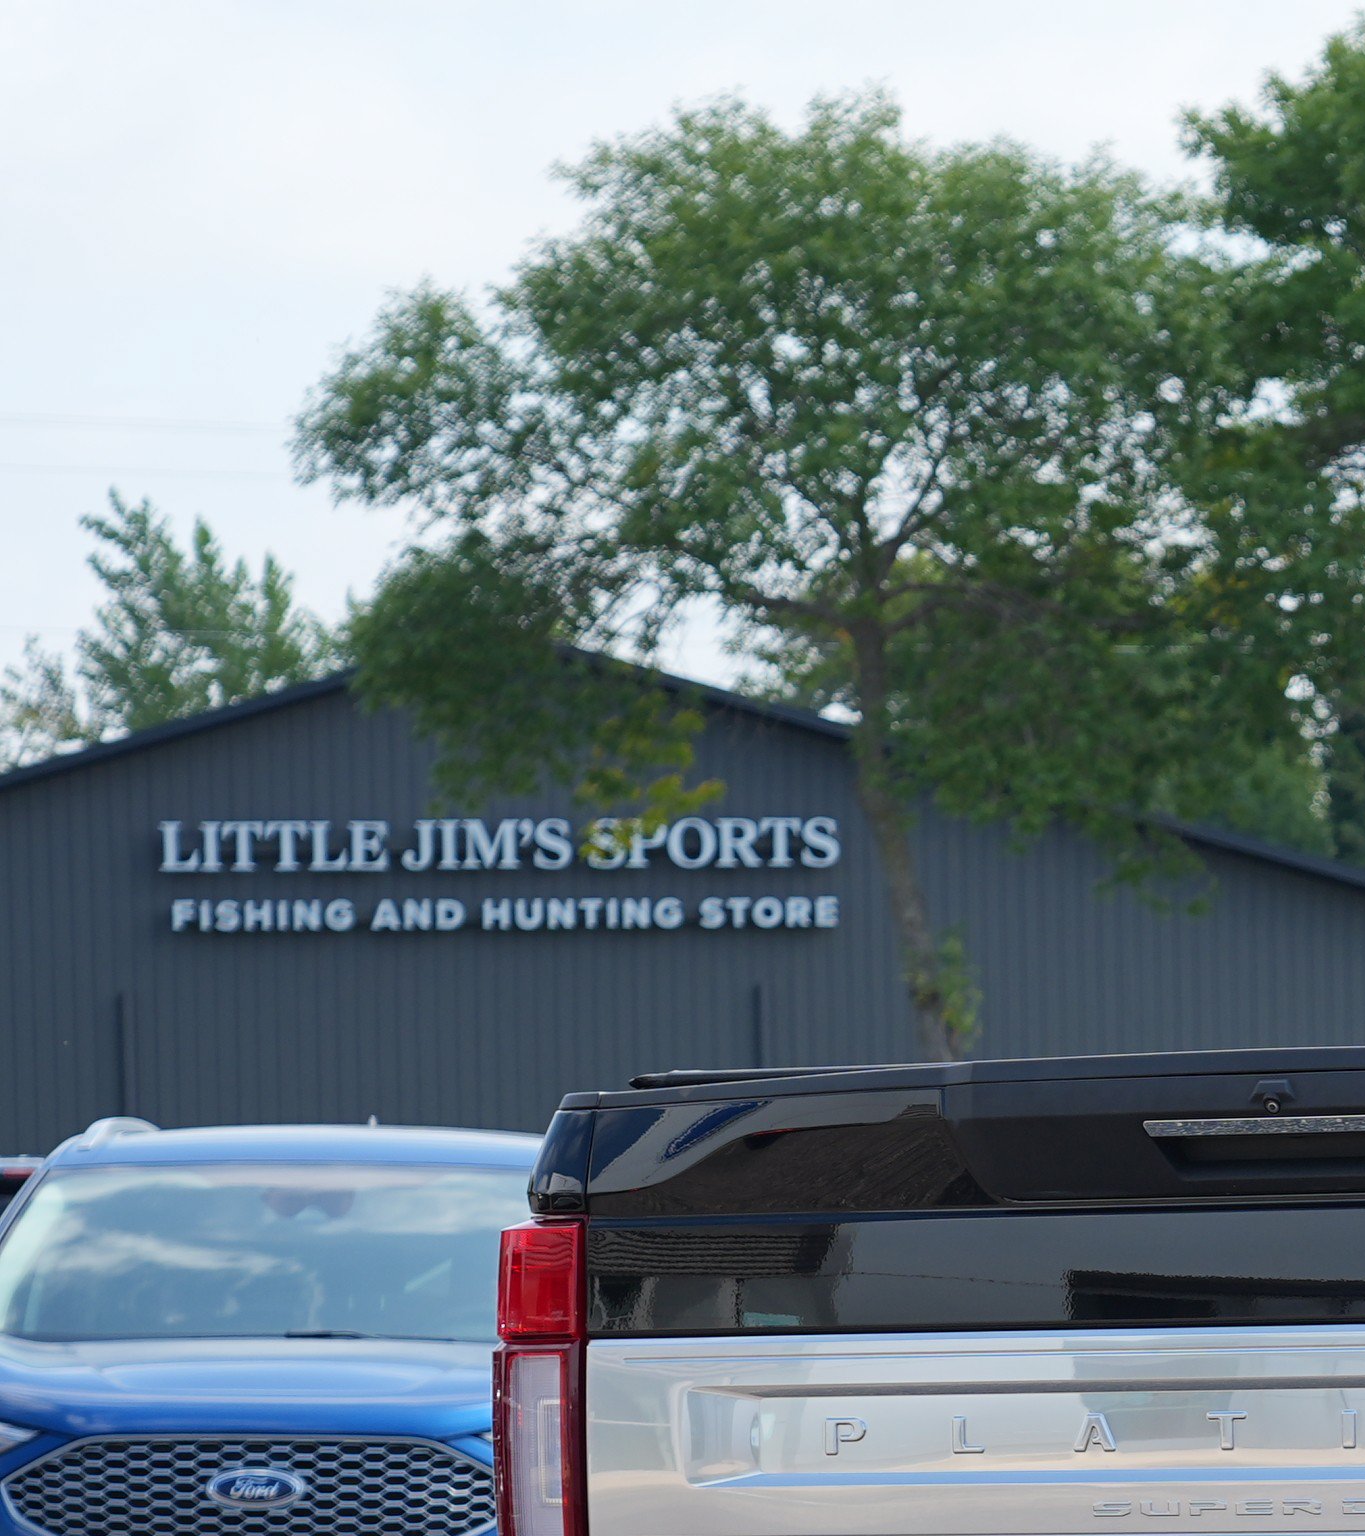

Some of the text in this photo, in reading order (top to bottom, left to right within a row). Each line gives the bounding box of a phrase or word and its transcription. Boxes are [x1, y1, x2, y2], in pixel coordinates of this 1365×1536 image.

[157, 816, 842, 873] LITTLE JIM'S SPORTS
[170, 895, 840, 932] FISHING AND HUNTING STORE
[230, 1476, 280, 1499] Ford
[1092, 1500, 1322, 1519] SUPER
